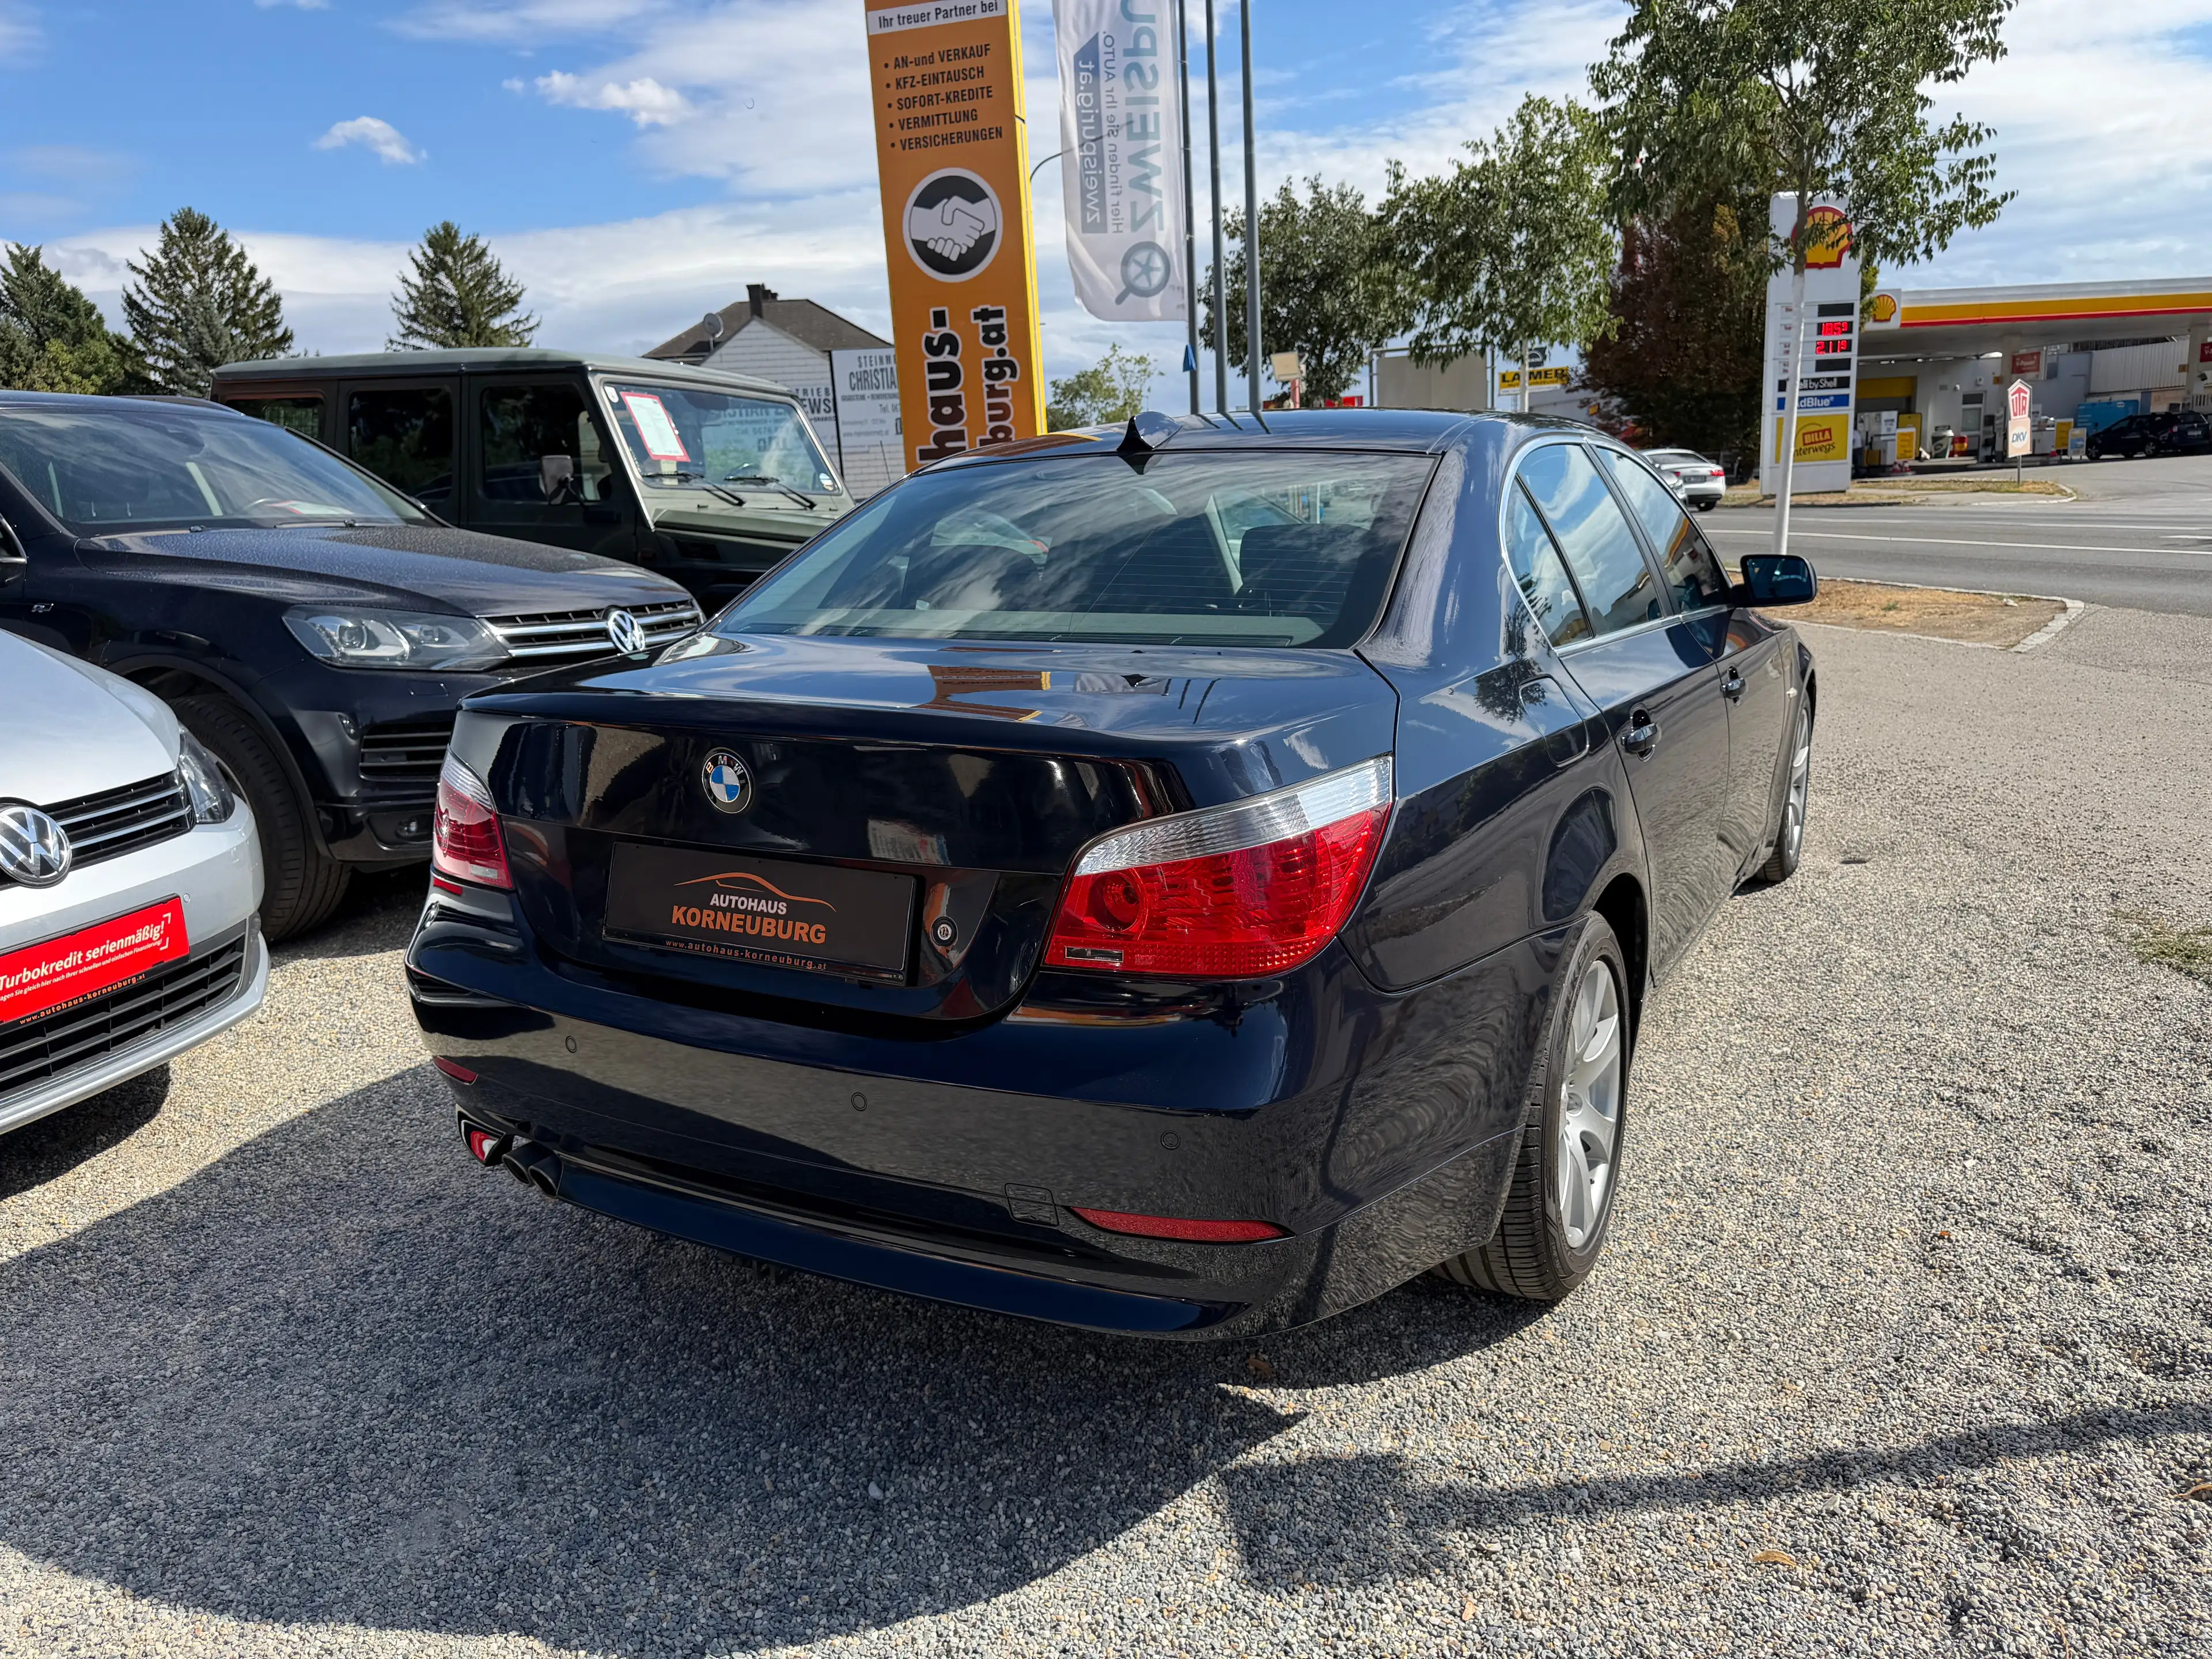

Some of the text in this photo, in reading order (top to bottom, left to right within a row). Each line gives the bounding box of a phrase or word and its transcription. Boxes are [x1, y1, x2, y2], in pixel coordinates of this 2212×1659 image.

[878, 0, 998, 28] Ihr treuer Partner bei
[893, 43, 991, 70] AN-und VERKAUF
[895, 66, 984, 90] KFZ-EINTAUSCH
[897, 85, 993, 111] SOFORT-KREDITE
[898, 108, 978, 131] VERMITTLUNG
[900, 126, 1003, 151] VERSICHERUNGEN
[849, 366, 897, 391] CHRISTIA
[919, 309, 967, 461] haus-
[974, 307, 1017, 447] burg.at
[1794, 441, 1836, 457] nterwegs
[1804, 429, 1831, 444] BILLA
[2011, 431, 2028, 443] DKV
[709, 893, 787, 915] AUTOHAUS
[671, 905, 826, 944] KORNEUBURG
[0, 920, 165, 991] Turbokredit serienmäßig!
[665, 939, 827, 970] www.autohaus-korneuburg.at
[0, 990, 14, 1002] agen
[24, 982, 41, 995] gleich
[41, 979, 52, 988] hier
[52, 975, 65, 983] nach
[65, 970, 78, 980] Ihrer
[78, 961, 102, 974] schnellen
[102, 958, 112, 967] und
[111, 950, 133, 963] einfachen
[19, 973, 146, 1025] www.autohaus-korneuburg.at
